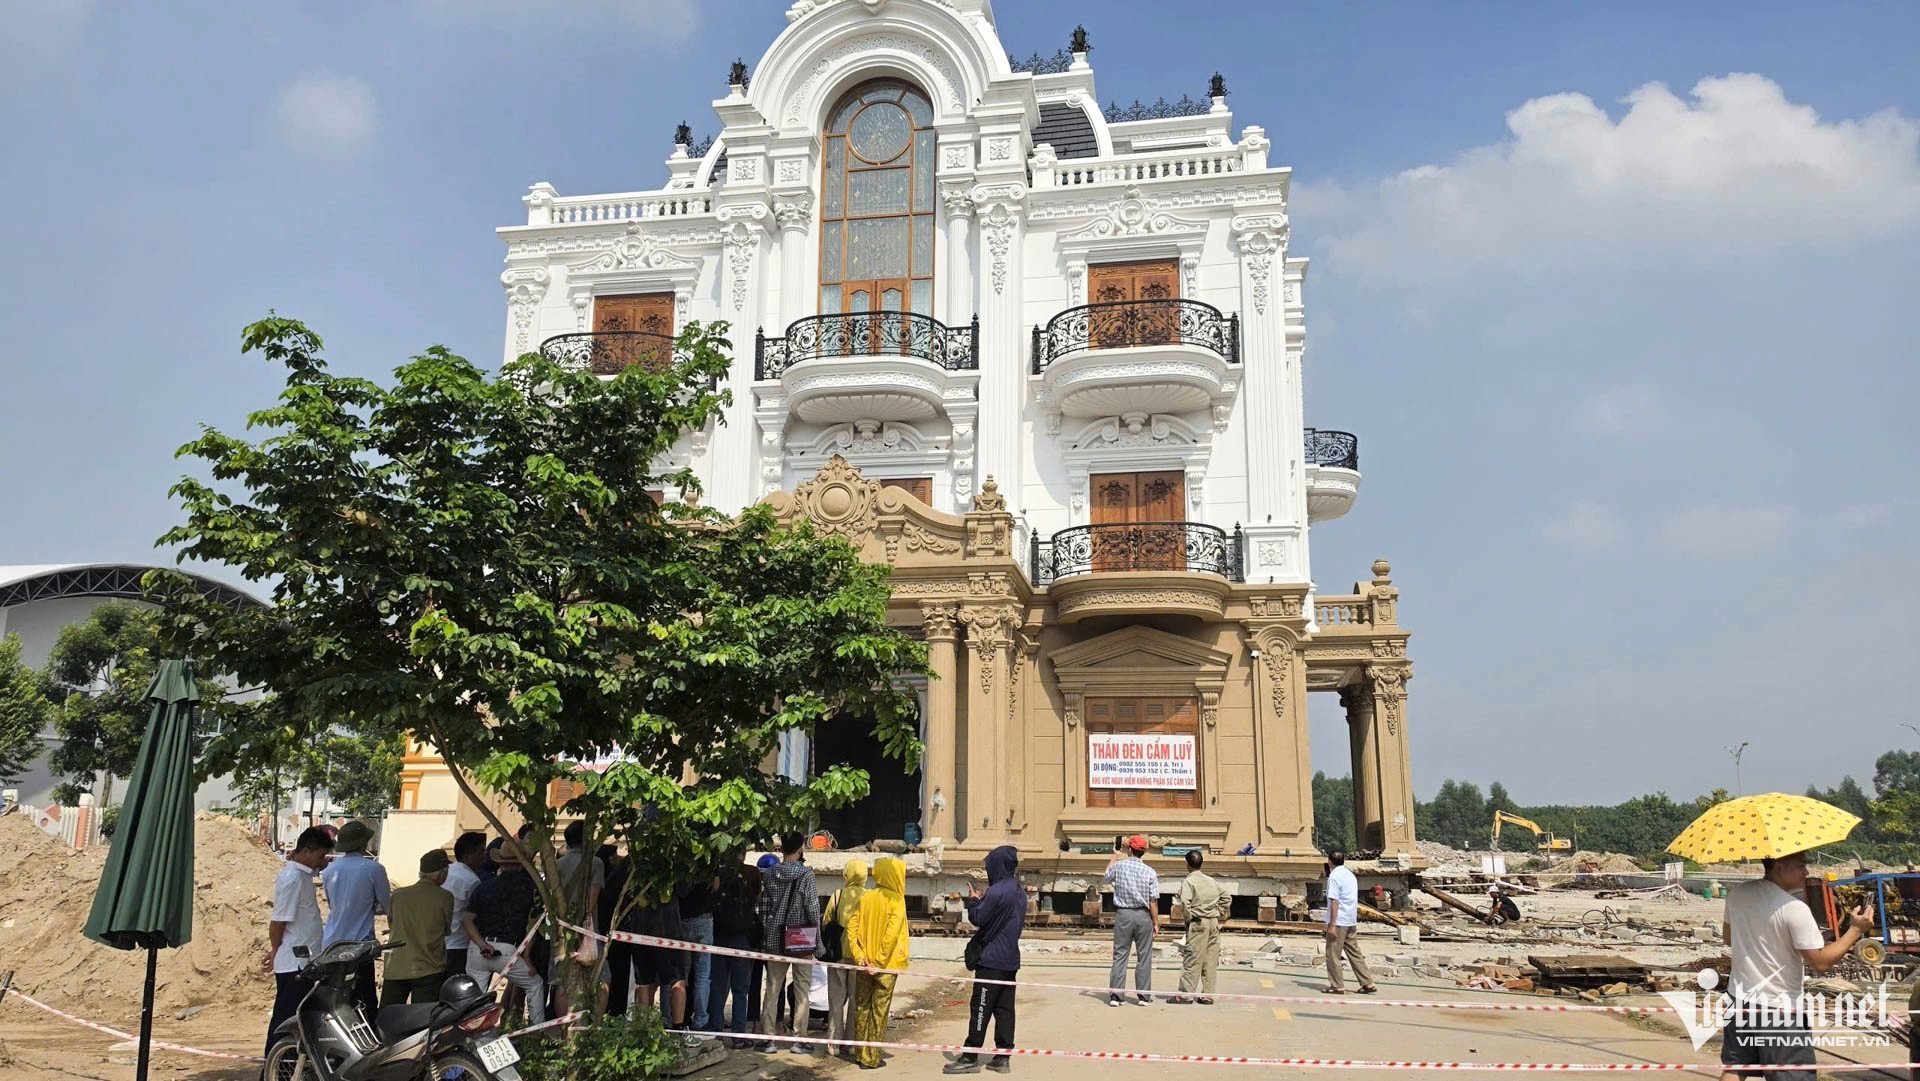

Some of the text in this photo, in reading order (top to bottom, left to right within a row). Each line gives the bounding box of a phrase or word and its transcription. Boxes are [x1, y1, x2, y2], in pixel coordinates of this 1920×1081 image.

[1122, 739, 1143, 759] ĐÈN
[1146, 736, 1170, 760] CẨM
[1093, 761, 1119, 773] DI ĐỘNG:
[490, 1050, 515, 1069] 0945
